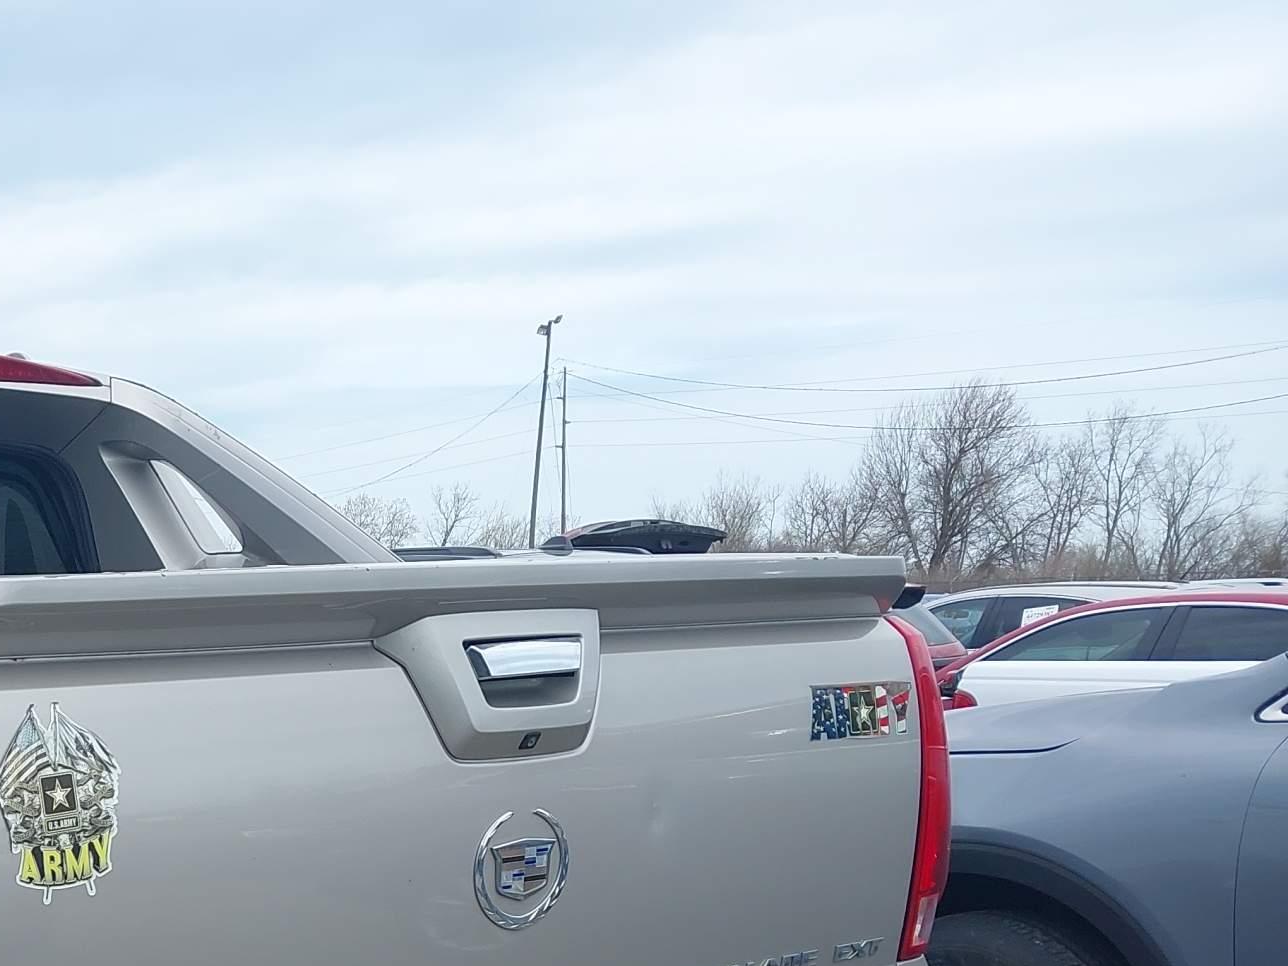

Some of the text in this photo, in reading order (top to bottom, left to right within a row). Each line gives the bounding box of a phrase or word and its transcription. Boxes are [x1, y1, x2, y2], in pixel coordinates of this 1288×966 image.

[59, 817, 77, 828] ARMY
[19, 829, 113, 886] ARMY
[832, 936, 885, 963] EXT
